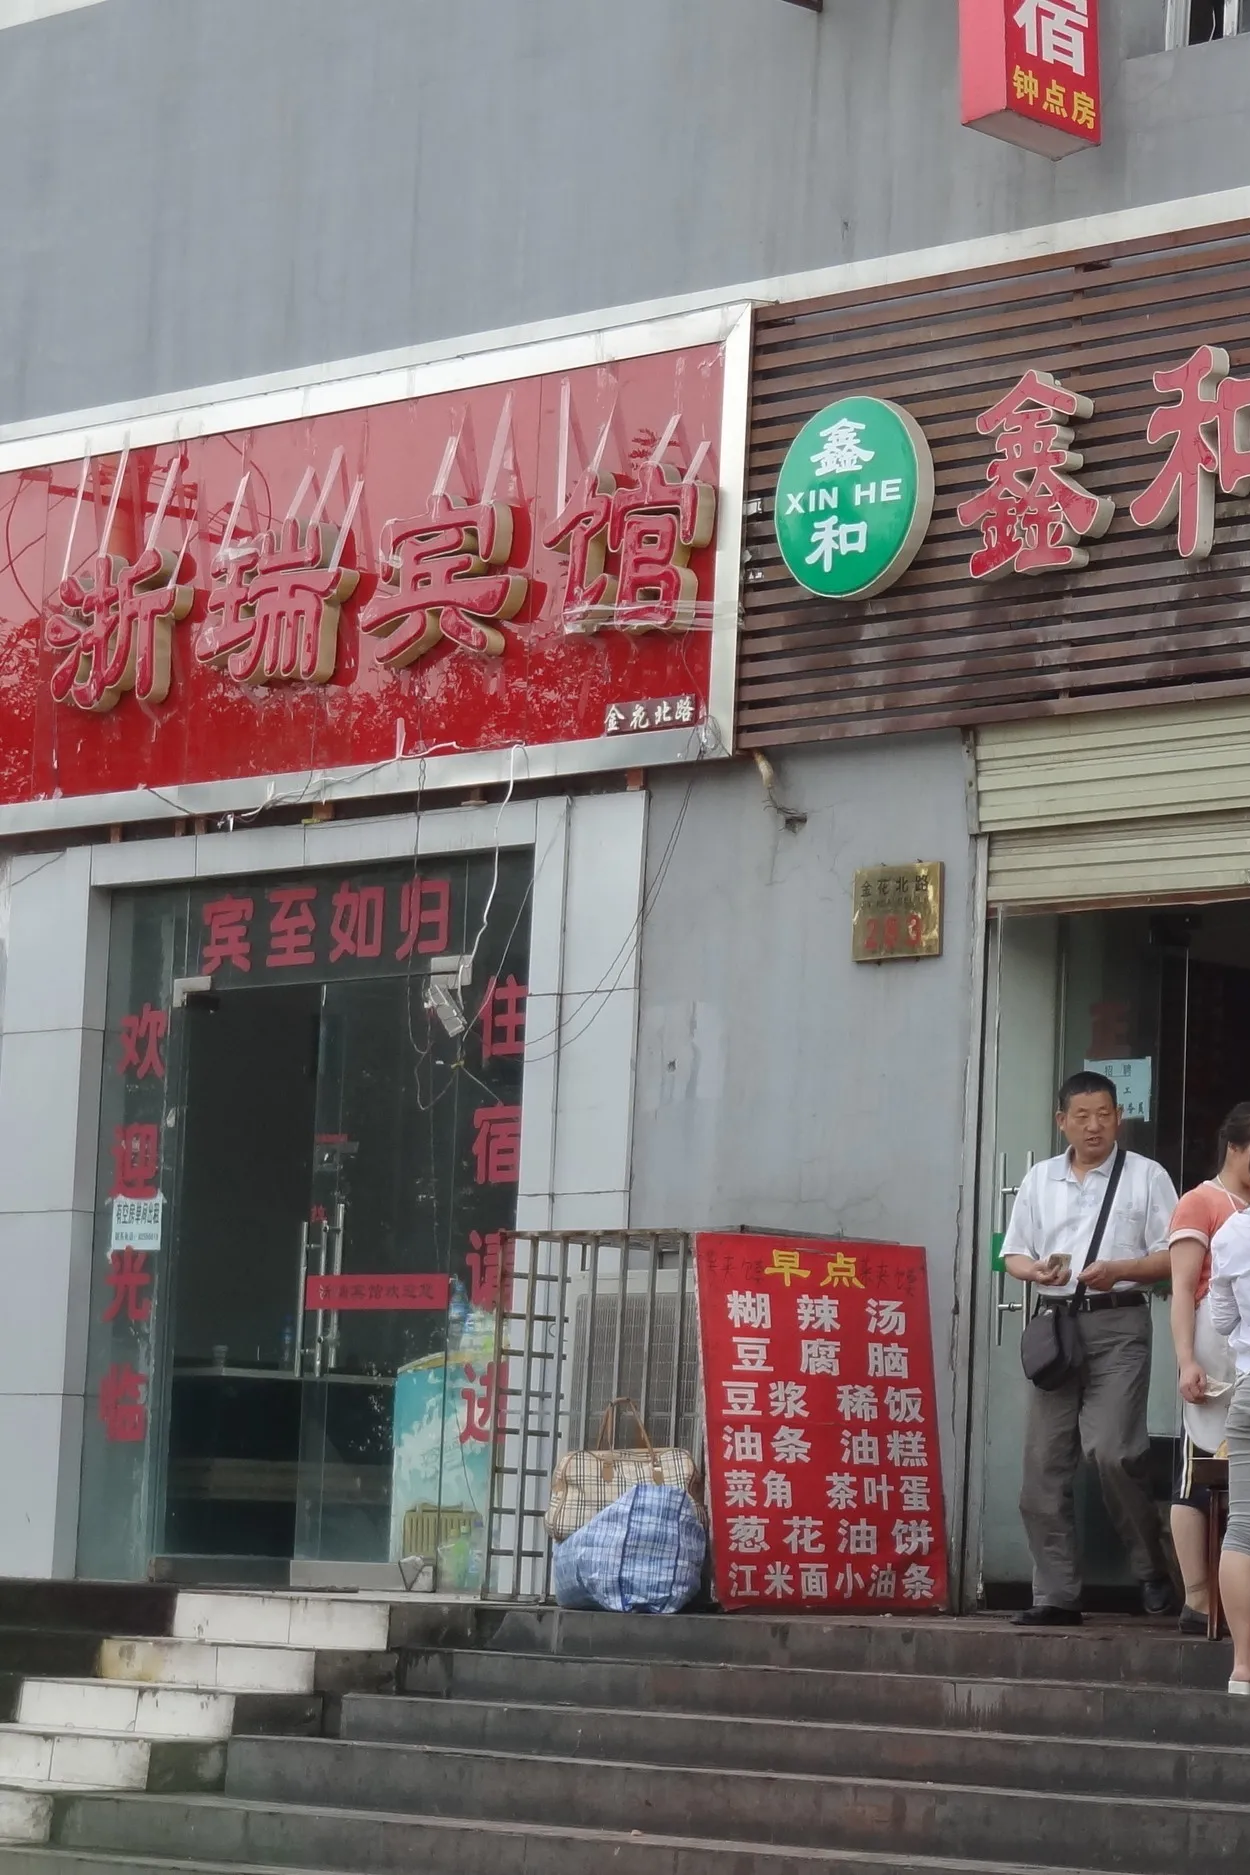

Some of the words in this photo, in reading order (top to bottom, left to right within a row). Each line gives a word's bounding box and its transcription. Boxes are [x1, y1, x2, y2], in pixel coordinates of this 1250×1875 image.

[1013, 0, 1088, 76] 宿
[1012, 64, 1096, 129] 钟点房
[810, 418, 875, 476] 鑫
[785, 487, 838, 515] XIN
[855, 478, 902, 506] HE
[805, 515, 868, 573] 和
[47, 462, 716, 711] 浙瑞宾馆
[604, 696, 695, 732] 金花北路
[861, 874, 929, 897] 金花北路
[202, 878, 450, 973] 宾至如归
[100, 1001, 168, 1442] 欢迎光临
[764, 1249, 866, 1288] 早点
[727, 1290, 906, 1336] 糊辣汤
[732, 1336, 909, 1379] 豆腐脑
[722, 1381, 810, 1419] 豆浆
[837, 1384, 925, 1424] 稀饭
[722, 1424, 811, 1464] 油条
[840, 1428, 928, 1467] 油糕
[724, 1469, 792, 1509] 菜角
[826, 1472, 931, 1511] 茶叶蛋
[726, 1515, 934, 1556] 葱花油饼
[728, 1560, 935, 1600] 江米面小油条
